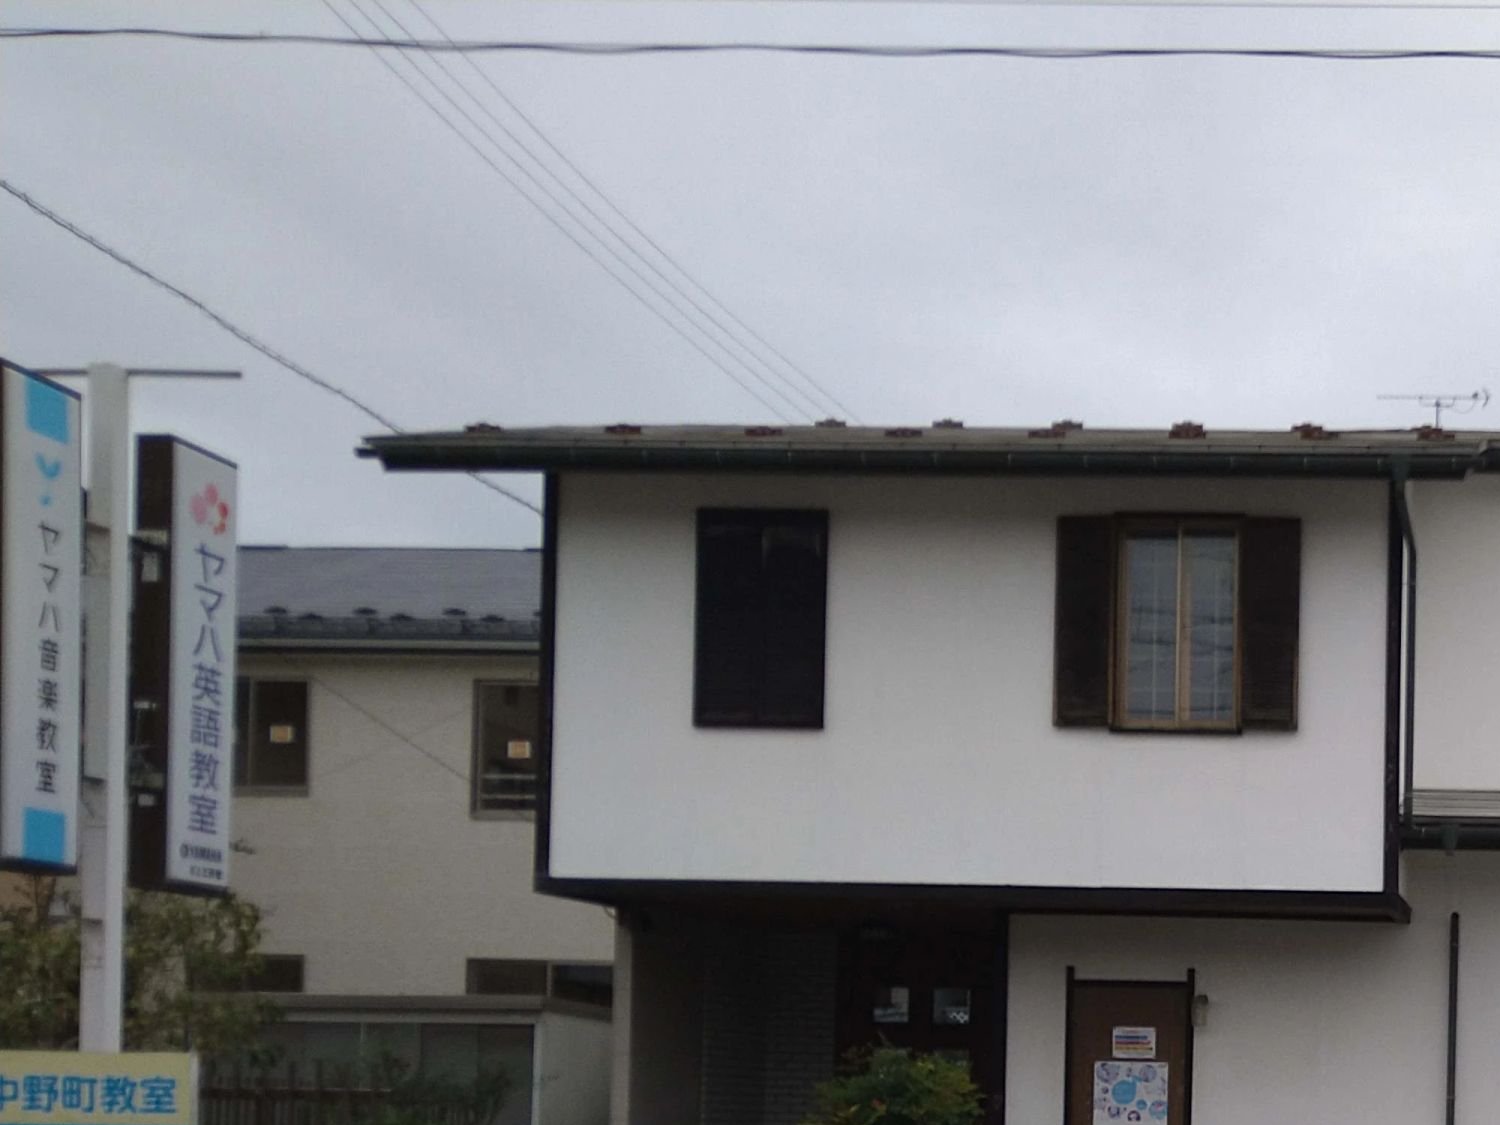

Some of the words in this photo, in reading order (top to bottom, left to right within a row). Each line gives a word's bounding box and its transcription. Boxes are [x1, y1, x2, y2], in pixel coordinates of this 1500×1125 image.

[36, 522, 61, 794] ヤマハ音楽教室
[188, 544, 225, 836] ヤマハ英語教室
